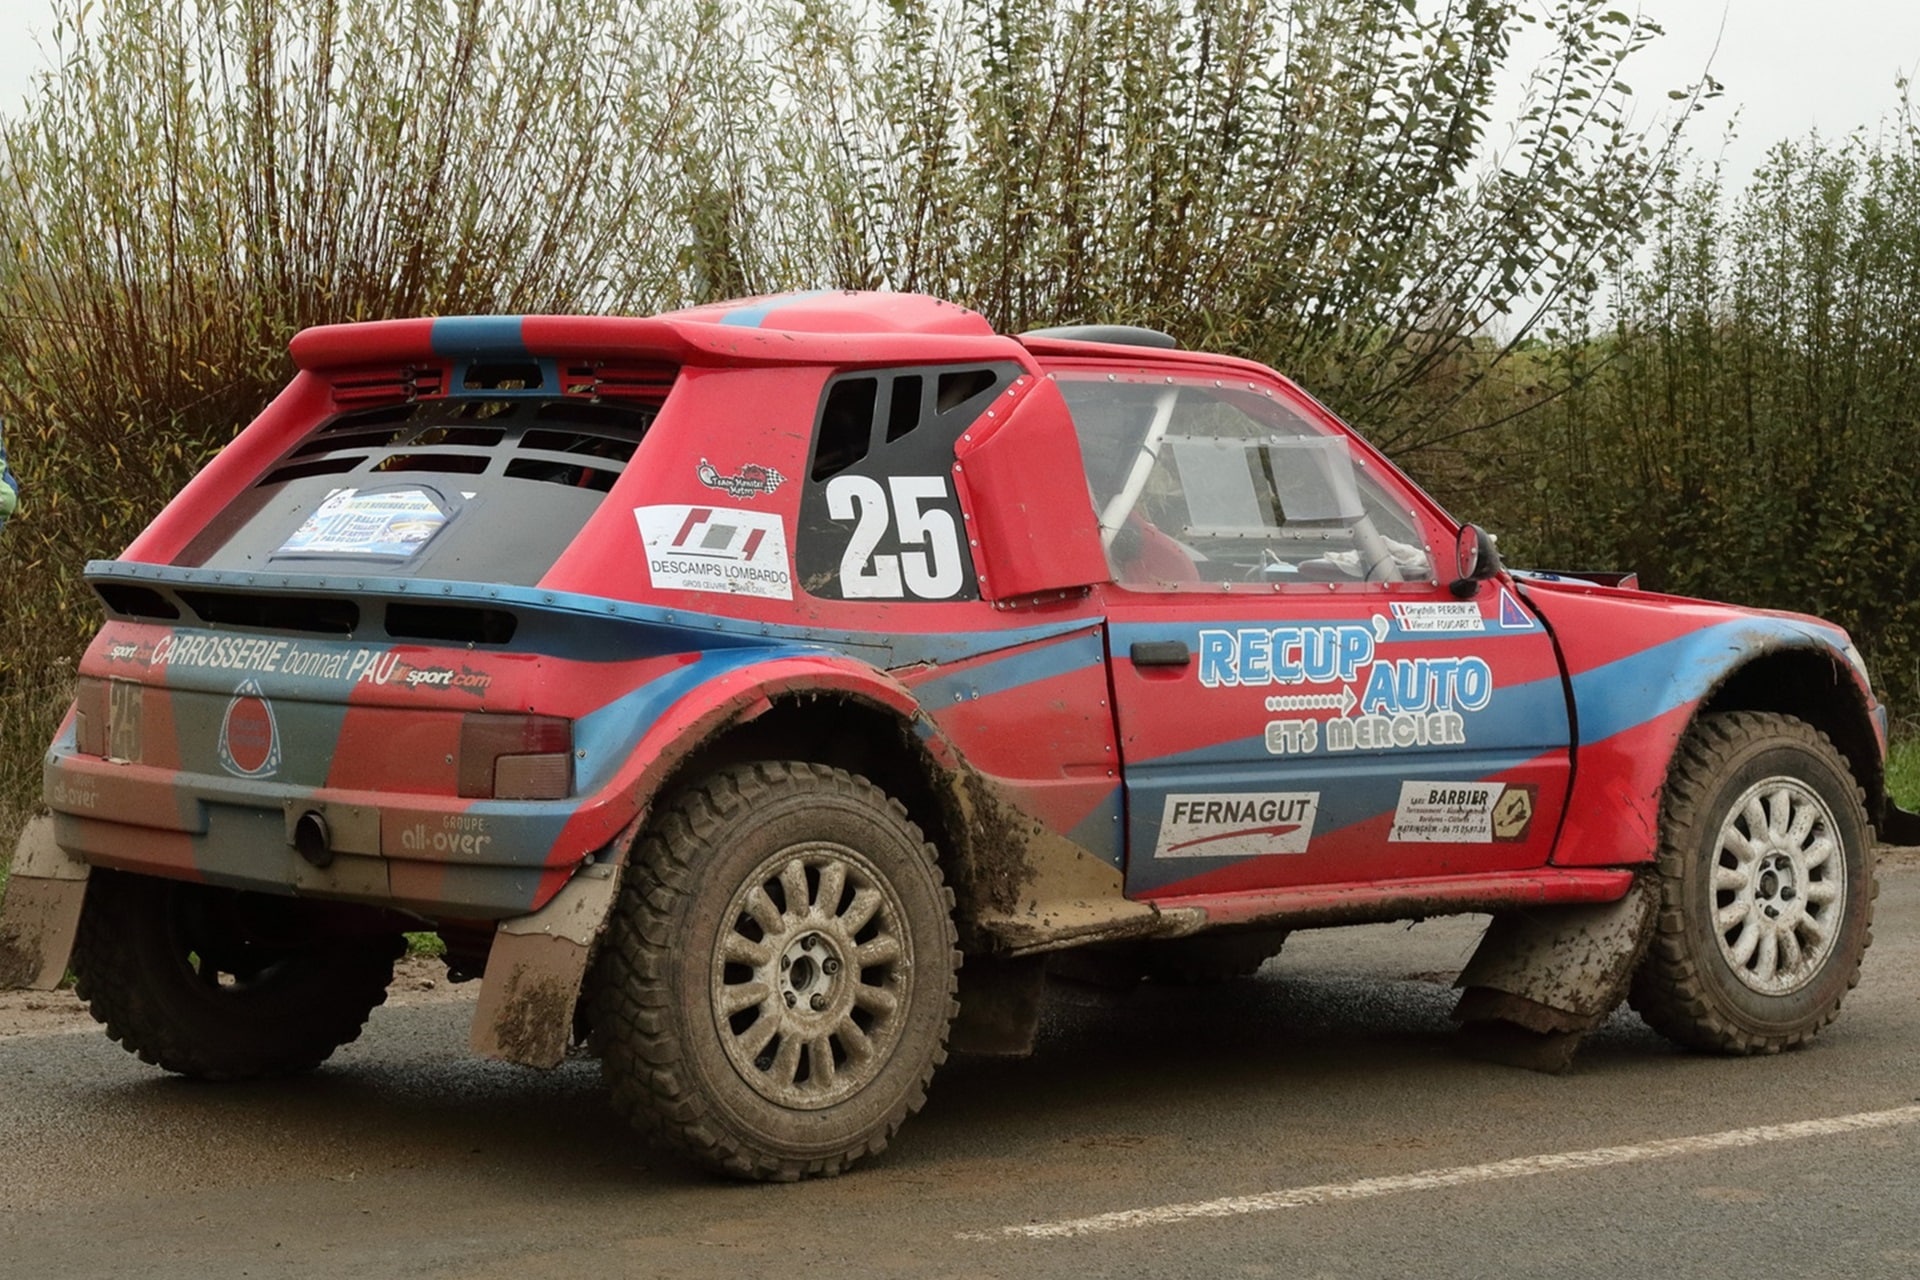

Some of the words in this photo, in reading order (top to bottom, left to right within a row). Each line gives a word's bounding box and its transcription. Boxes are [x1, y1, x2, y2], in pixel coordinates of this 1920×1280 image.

[825, 474, 963, 599] 25
[651, 560, 722, 577] DESCAMPS
[724, 565, 788, 584] LOMBARDO
[151, 635, 288, 672] CARROSSERIE
[281, 643, 351, 679] bonnat
[346, 648, 400, 685] PAU
[1199, 614, 1390, 687] RECUP'
[1361, 656, 1492, 716] AUTO
[1265, 718, 1318, 754] ETS
[1326, 711, 1466, 752] MERCIER
[1172, 799, 1311, 826] FERNAGUT
[1427, 789, 1489, 806] BARBIER
[442, 815, 484, 832] GROUPE
